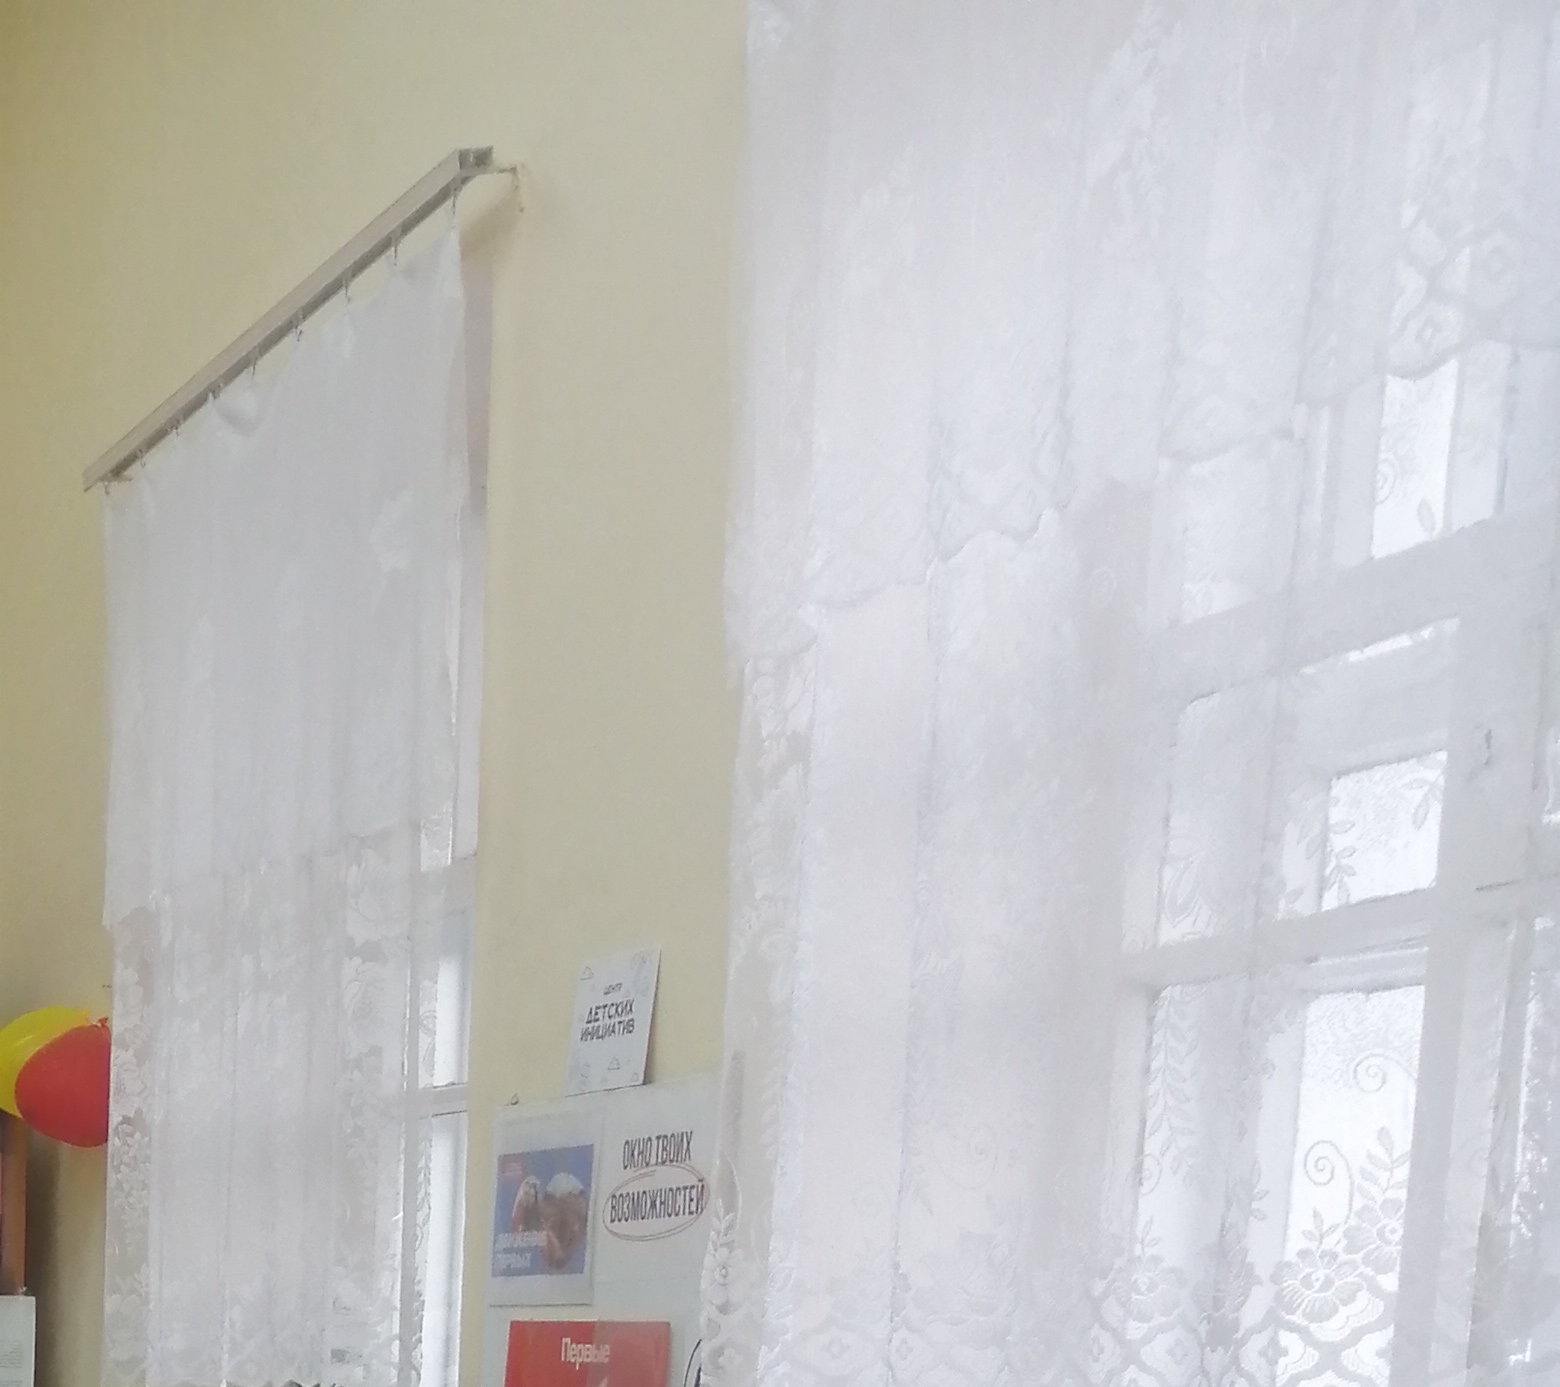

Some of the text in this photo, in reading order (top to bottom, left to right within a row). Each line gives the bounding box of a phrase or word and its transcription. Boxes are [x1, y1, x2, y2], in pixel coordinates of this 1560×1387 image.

[586, 998, 635, 1025] ДЕТСКИХ
[580, 1018, 635, 1042] ИНИЦИАТИВ
[622, 1130, 693, 1170] ОКНО ТВОИХ
[609, 1178, 705, 1223] ВОЗМОЖНОСТЕЙ
[561, 1337, 610, 1370] Первые
